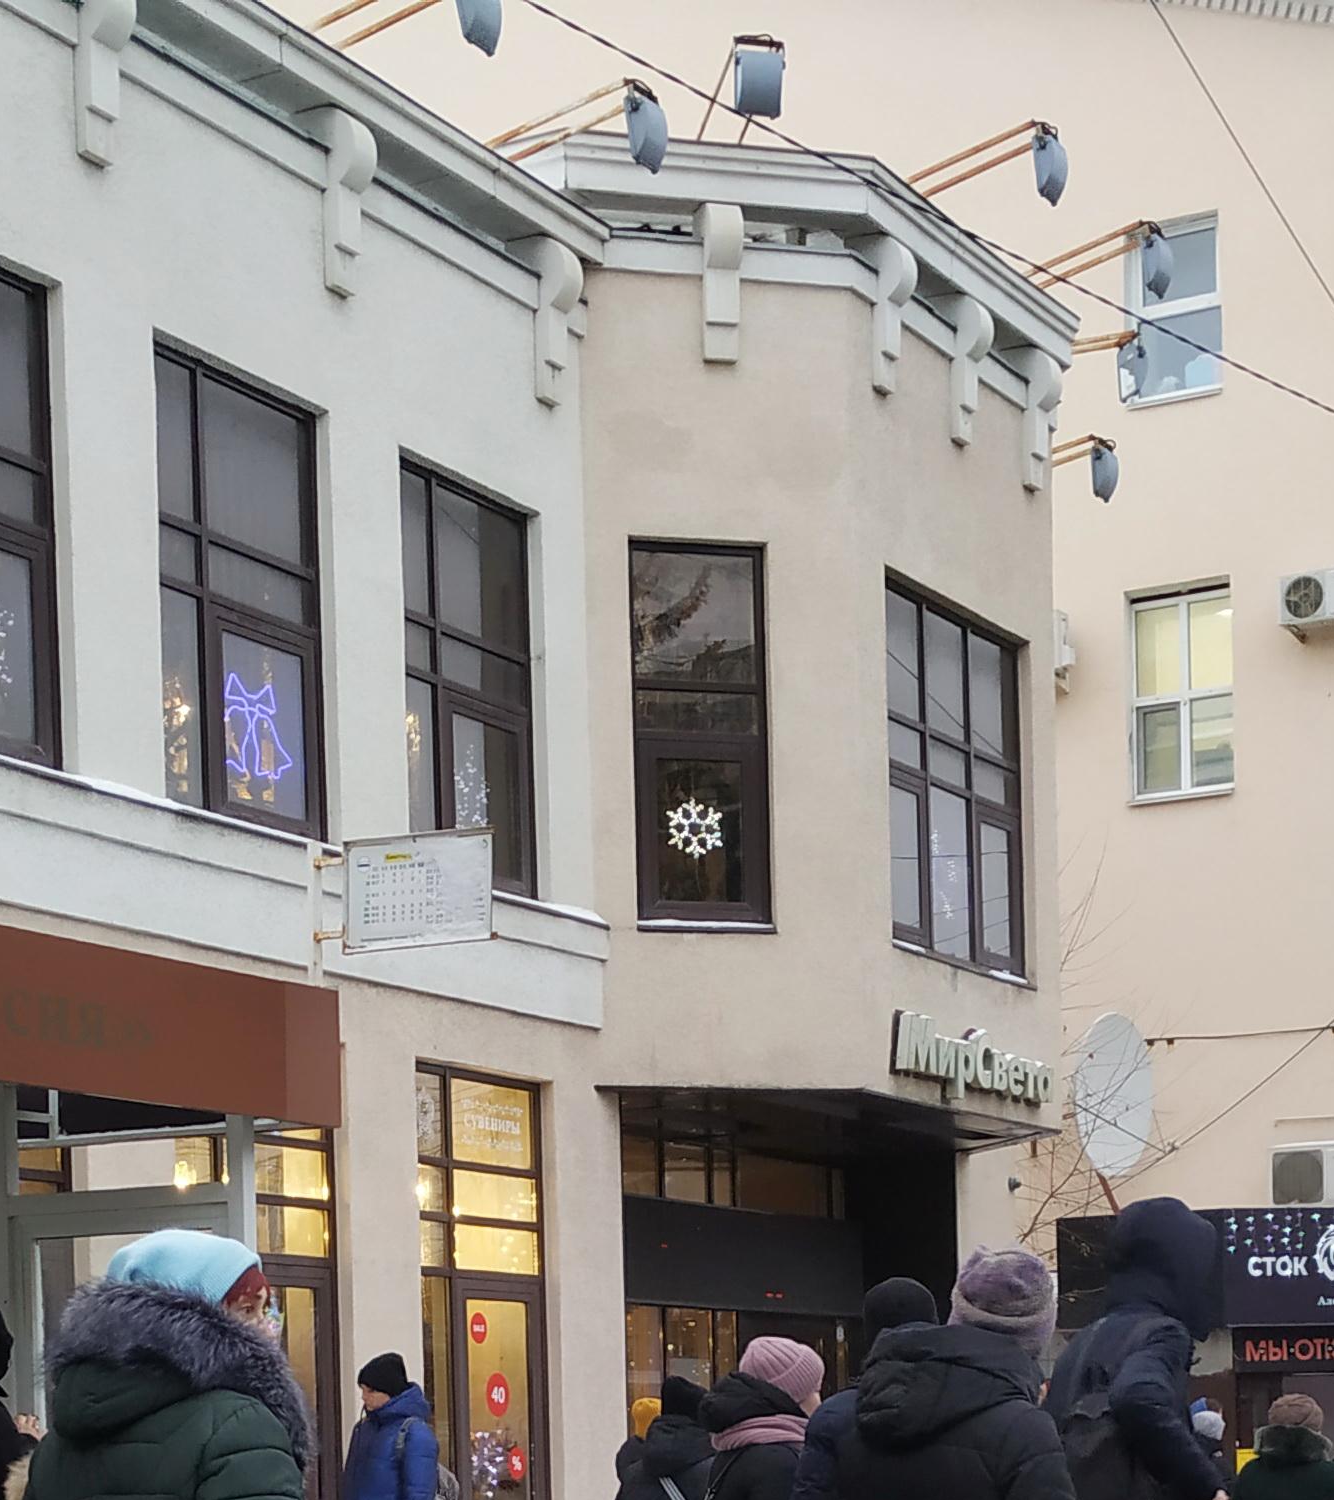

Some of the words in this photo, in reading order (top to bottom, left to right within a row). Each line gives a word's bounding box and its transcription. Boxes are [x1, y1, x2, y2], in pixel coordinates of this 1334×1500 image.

[464, 1114, 521, 1135] СУВЕНИРЫ
[1248, 1255, 1309, 1277] СТОК
[1245, 1339, 1289, 1362] МЫ
[491, 1386, 506, 1404] 40
